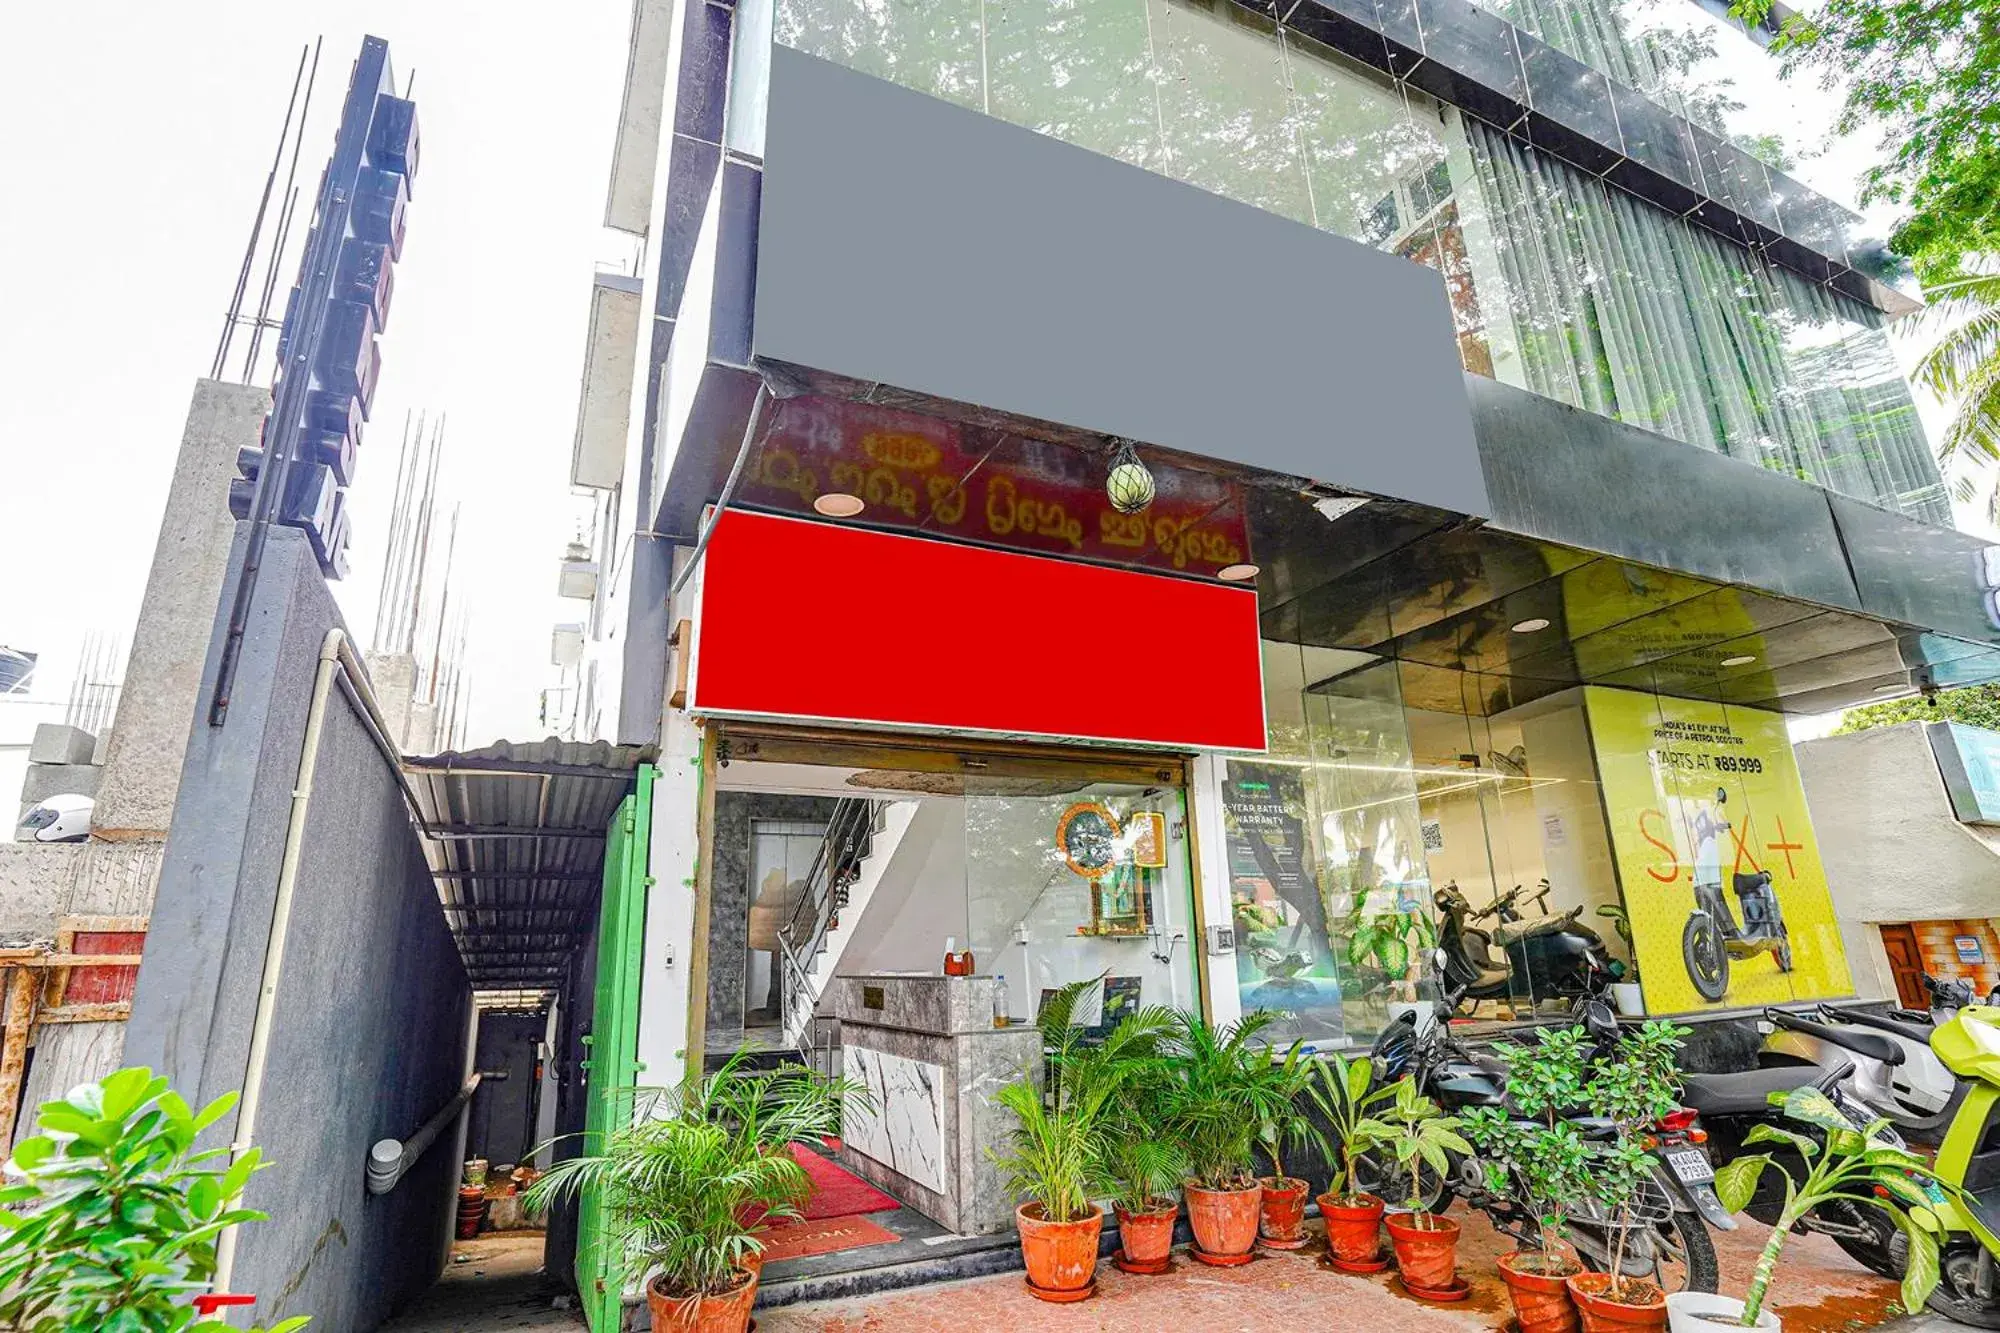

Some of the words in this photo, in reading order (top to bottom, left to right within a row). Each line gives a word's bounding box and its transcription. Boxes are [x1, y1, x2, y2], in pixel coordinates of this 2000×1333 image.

[1674, 731, 1683, 740] OF
[1690, 733, 1715, 744] PETROL
[1715, 736, 1744, 745] SCOOTER
[1697, 753, 1710, 770] AT
[1713, 756, 1762, 774] ₹89,999
[1256, 804, 1294, 815] BATTERY
[1233, 814, 1284, 825] WARRANTY
